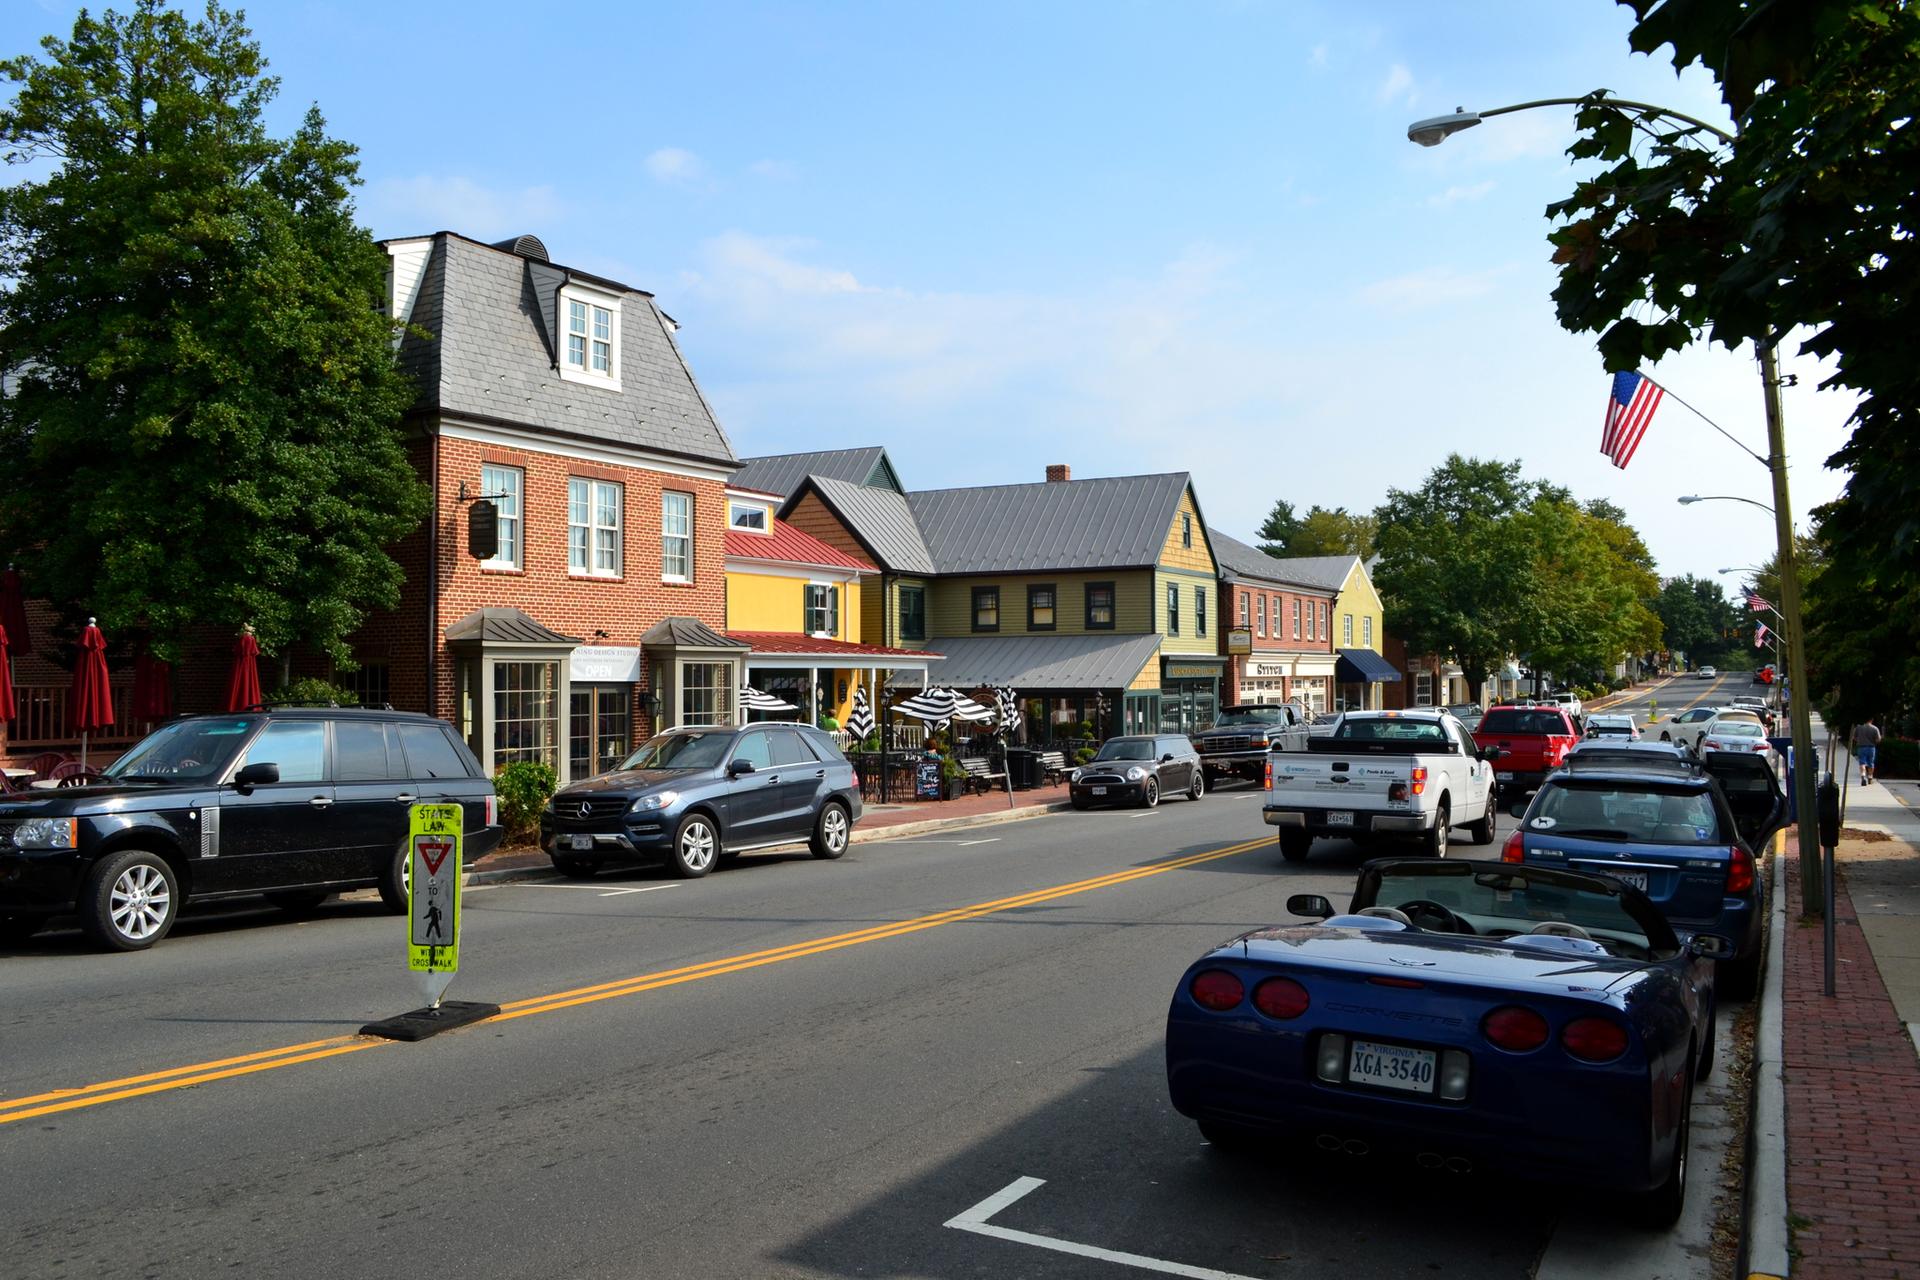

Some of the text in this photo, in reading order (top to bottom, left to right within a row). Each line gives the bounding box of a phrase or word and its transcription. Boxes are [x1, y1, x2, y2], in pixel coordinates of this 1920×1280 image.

[586, 665, 613, 677] OPEN
[419, 809, 452, 820] STATE
[423, 822, 446, 832] LAW
[427, 887, 439, 896] TO
[1324, 1001, 1465, 1026] CORVETTE
[1373, 1045, 1416, 1058] VIRGINIA
[1352, 1051, 1432, 1083] XGA-3540
